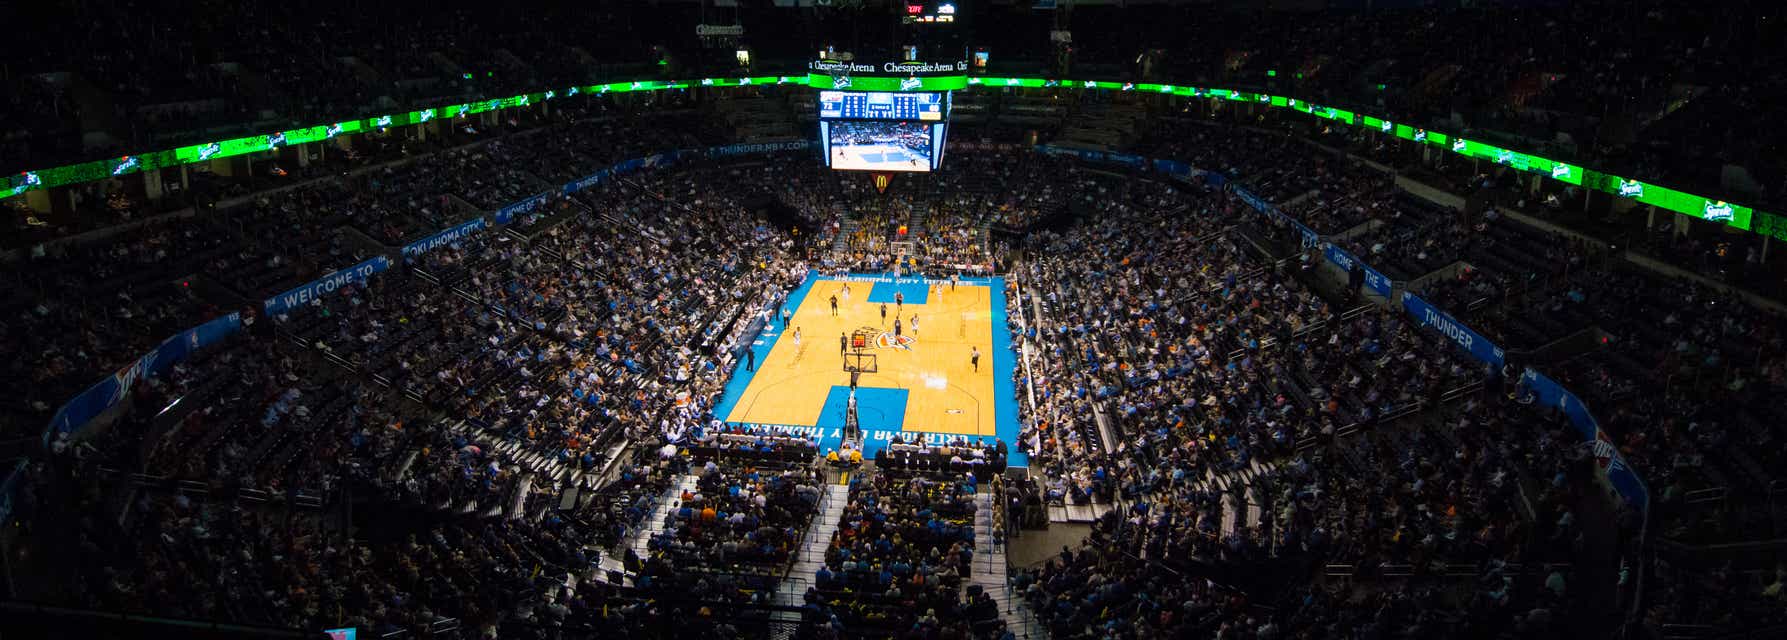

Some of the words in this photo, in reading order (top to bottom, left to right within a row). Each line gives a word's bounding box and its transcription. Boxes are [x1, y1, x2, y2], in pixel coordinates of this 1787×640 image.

[848, 62, 875, 72] Arena
[884, 62, 933, 75] Chesapeake
[933, 62, 954, 72] Arena
[1704, 204, 1734, 221] Sprite
[284, 271, 353, 308] WELCOME
[356, 264, 373, 277] TO
[1364, 269, 1379, 288] THE
[1424, 307, 1473, 351] THUNDER
